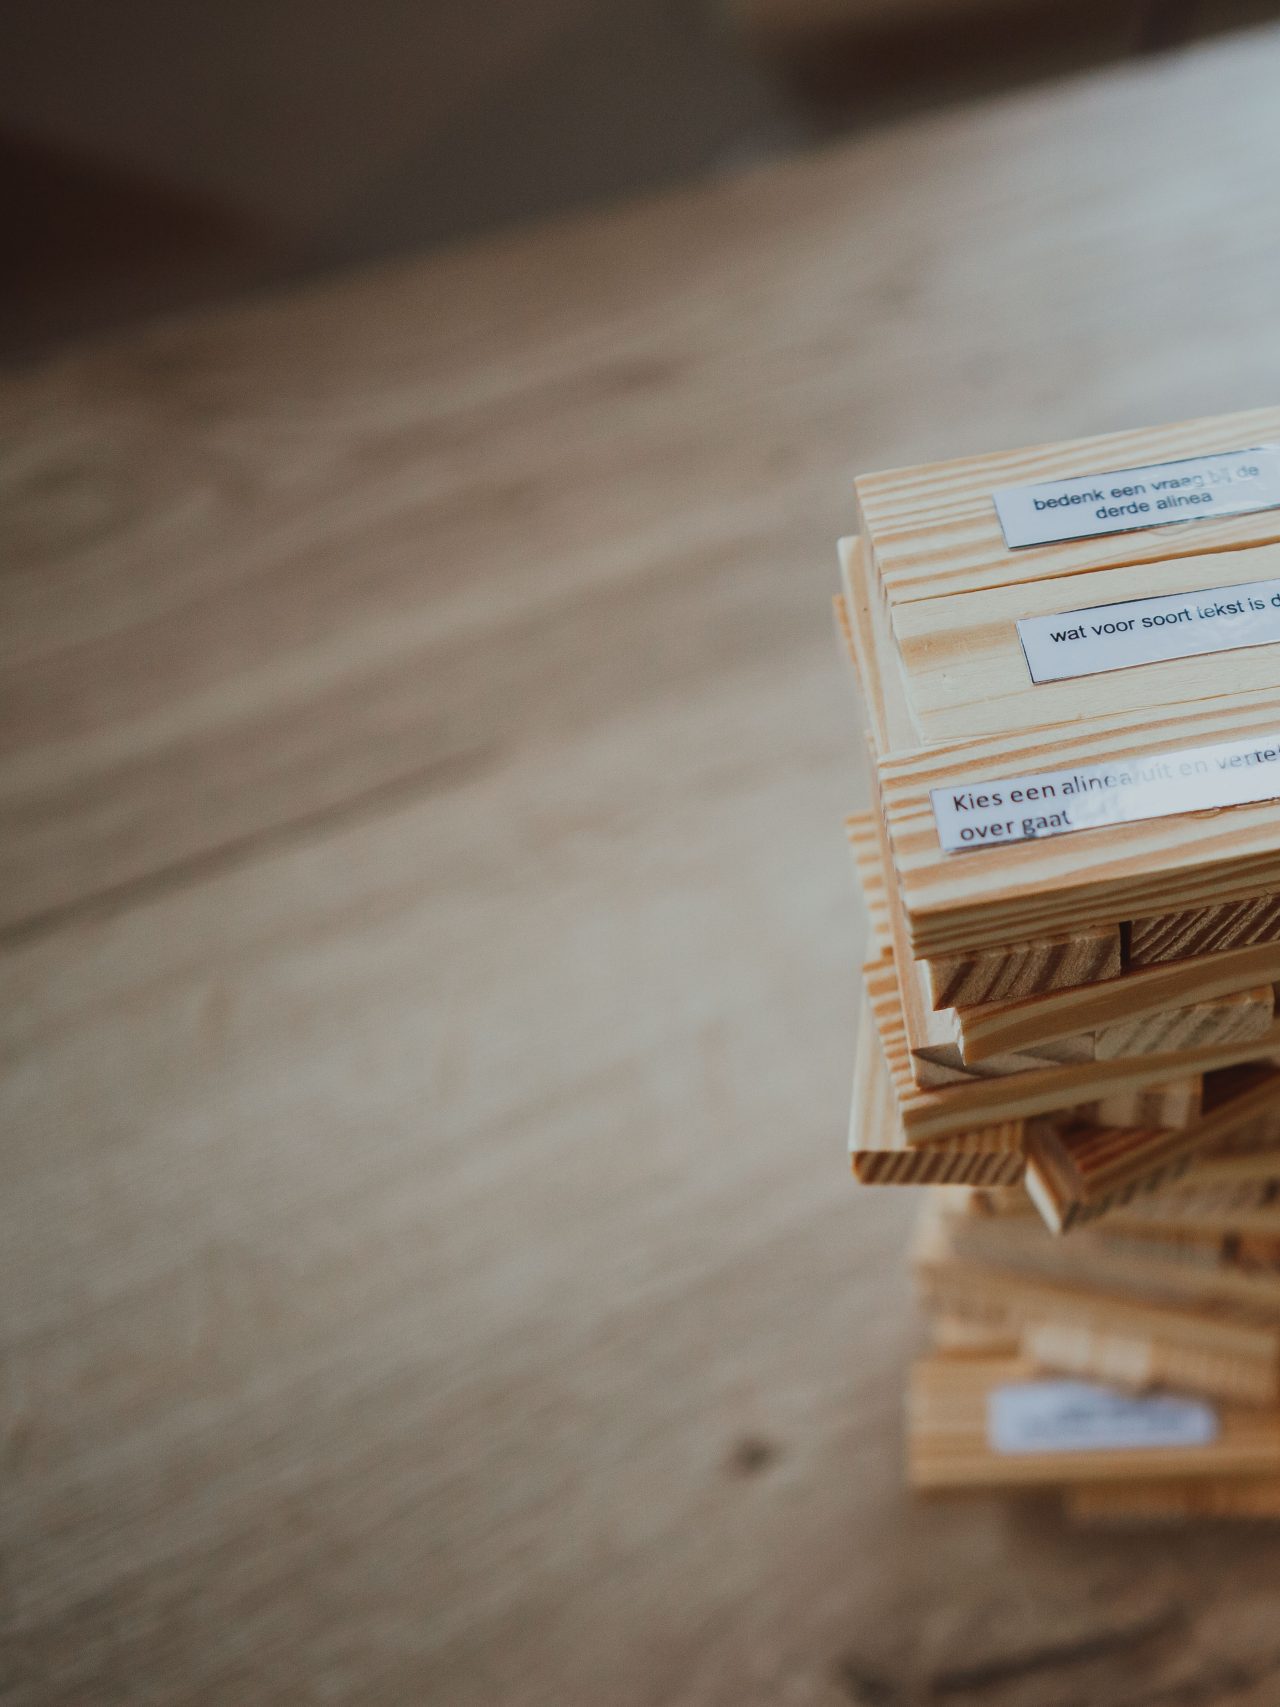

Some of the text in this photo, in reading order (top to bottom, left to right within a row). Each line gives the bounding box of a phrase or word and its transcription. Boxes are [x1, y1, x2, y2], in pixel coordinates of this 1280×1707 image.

[1033, 489, 1105, 511] bedenk
[1110, 484, 1146, 499] een
[1151, 475, 1203, 492] vraag
[1236, 464, 1260, 479] de
[1096, 492, 1213, 520] derde alinea
[1050, 625, 1087, 643] wat
[1091, 617, 1136, 636] voor
[1141, 608, 1192, 628] soort
[1196, 599, 1245, 619] tekst
[1247, 597, 1266, 612] is
[953, 793, 1004, 811] Kies
[1010, 784, 1056, 803] een
[1062, 772, 1133, 795] alinea
[1179, 759, 1208, 776] en
[960, 810, 1072, 841] over gaat
